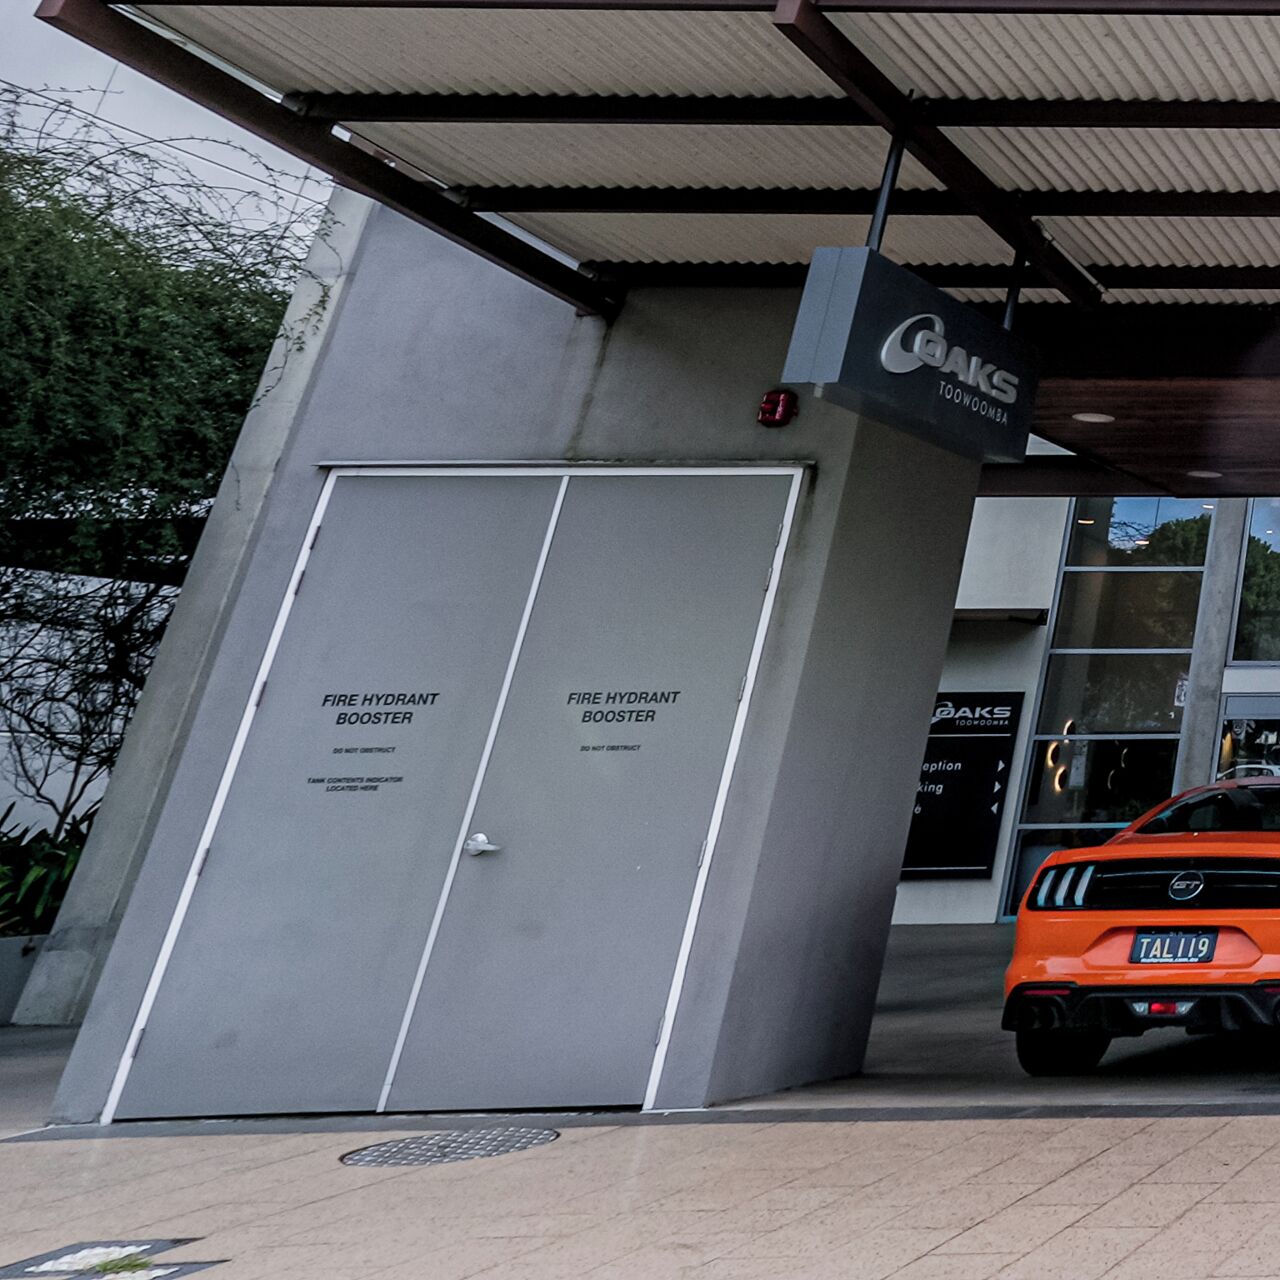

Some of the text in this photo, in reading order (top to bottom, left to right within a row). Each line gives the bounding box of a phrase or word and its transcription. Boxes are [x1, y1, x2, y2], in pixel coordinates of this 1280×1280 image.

[913, 329, 1019, 404] OAKS
[939, 381, 1008, 425] TOOWOOMBA
[321, 693, 440, 707] FIRE HYDRANT
[567, 691, 681, 705] FIRE HYDRANT
[336, 711, 414, 725] BOOSTER
[582, 710, 656, 723] BOOSTER
[936, 706, 1012, 719] OAKS
[922, 760, 962, 773] eption
[916, 781, 944, 795] king
[1172, 880, 1201, 889] GT
